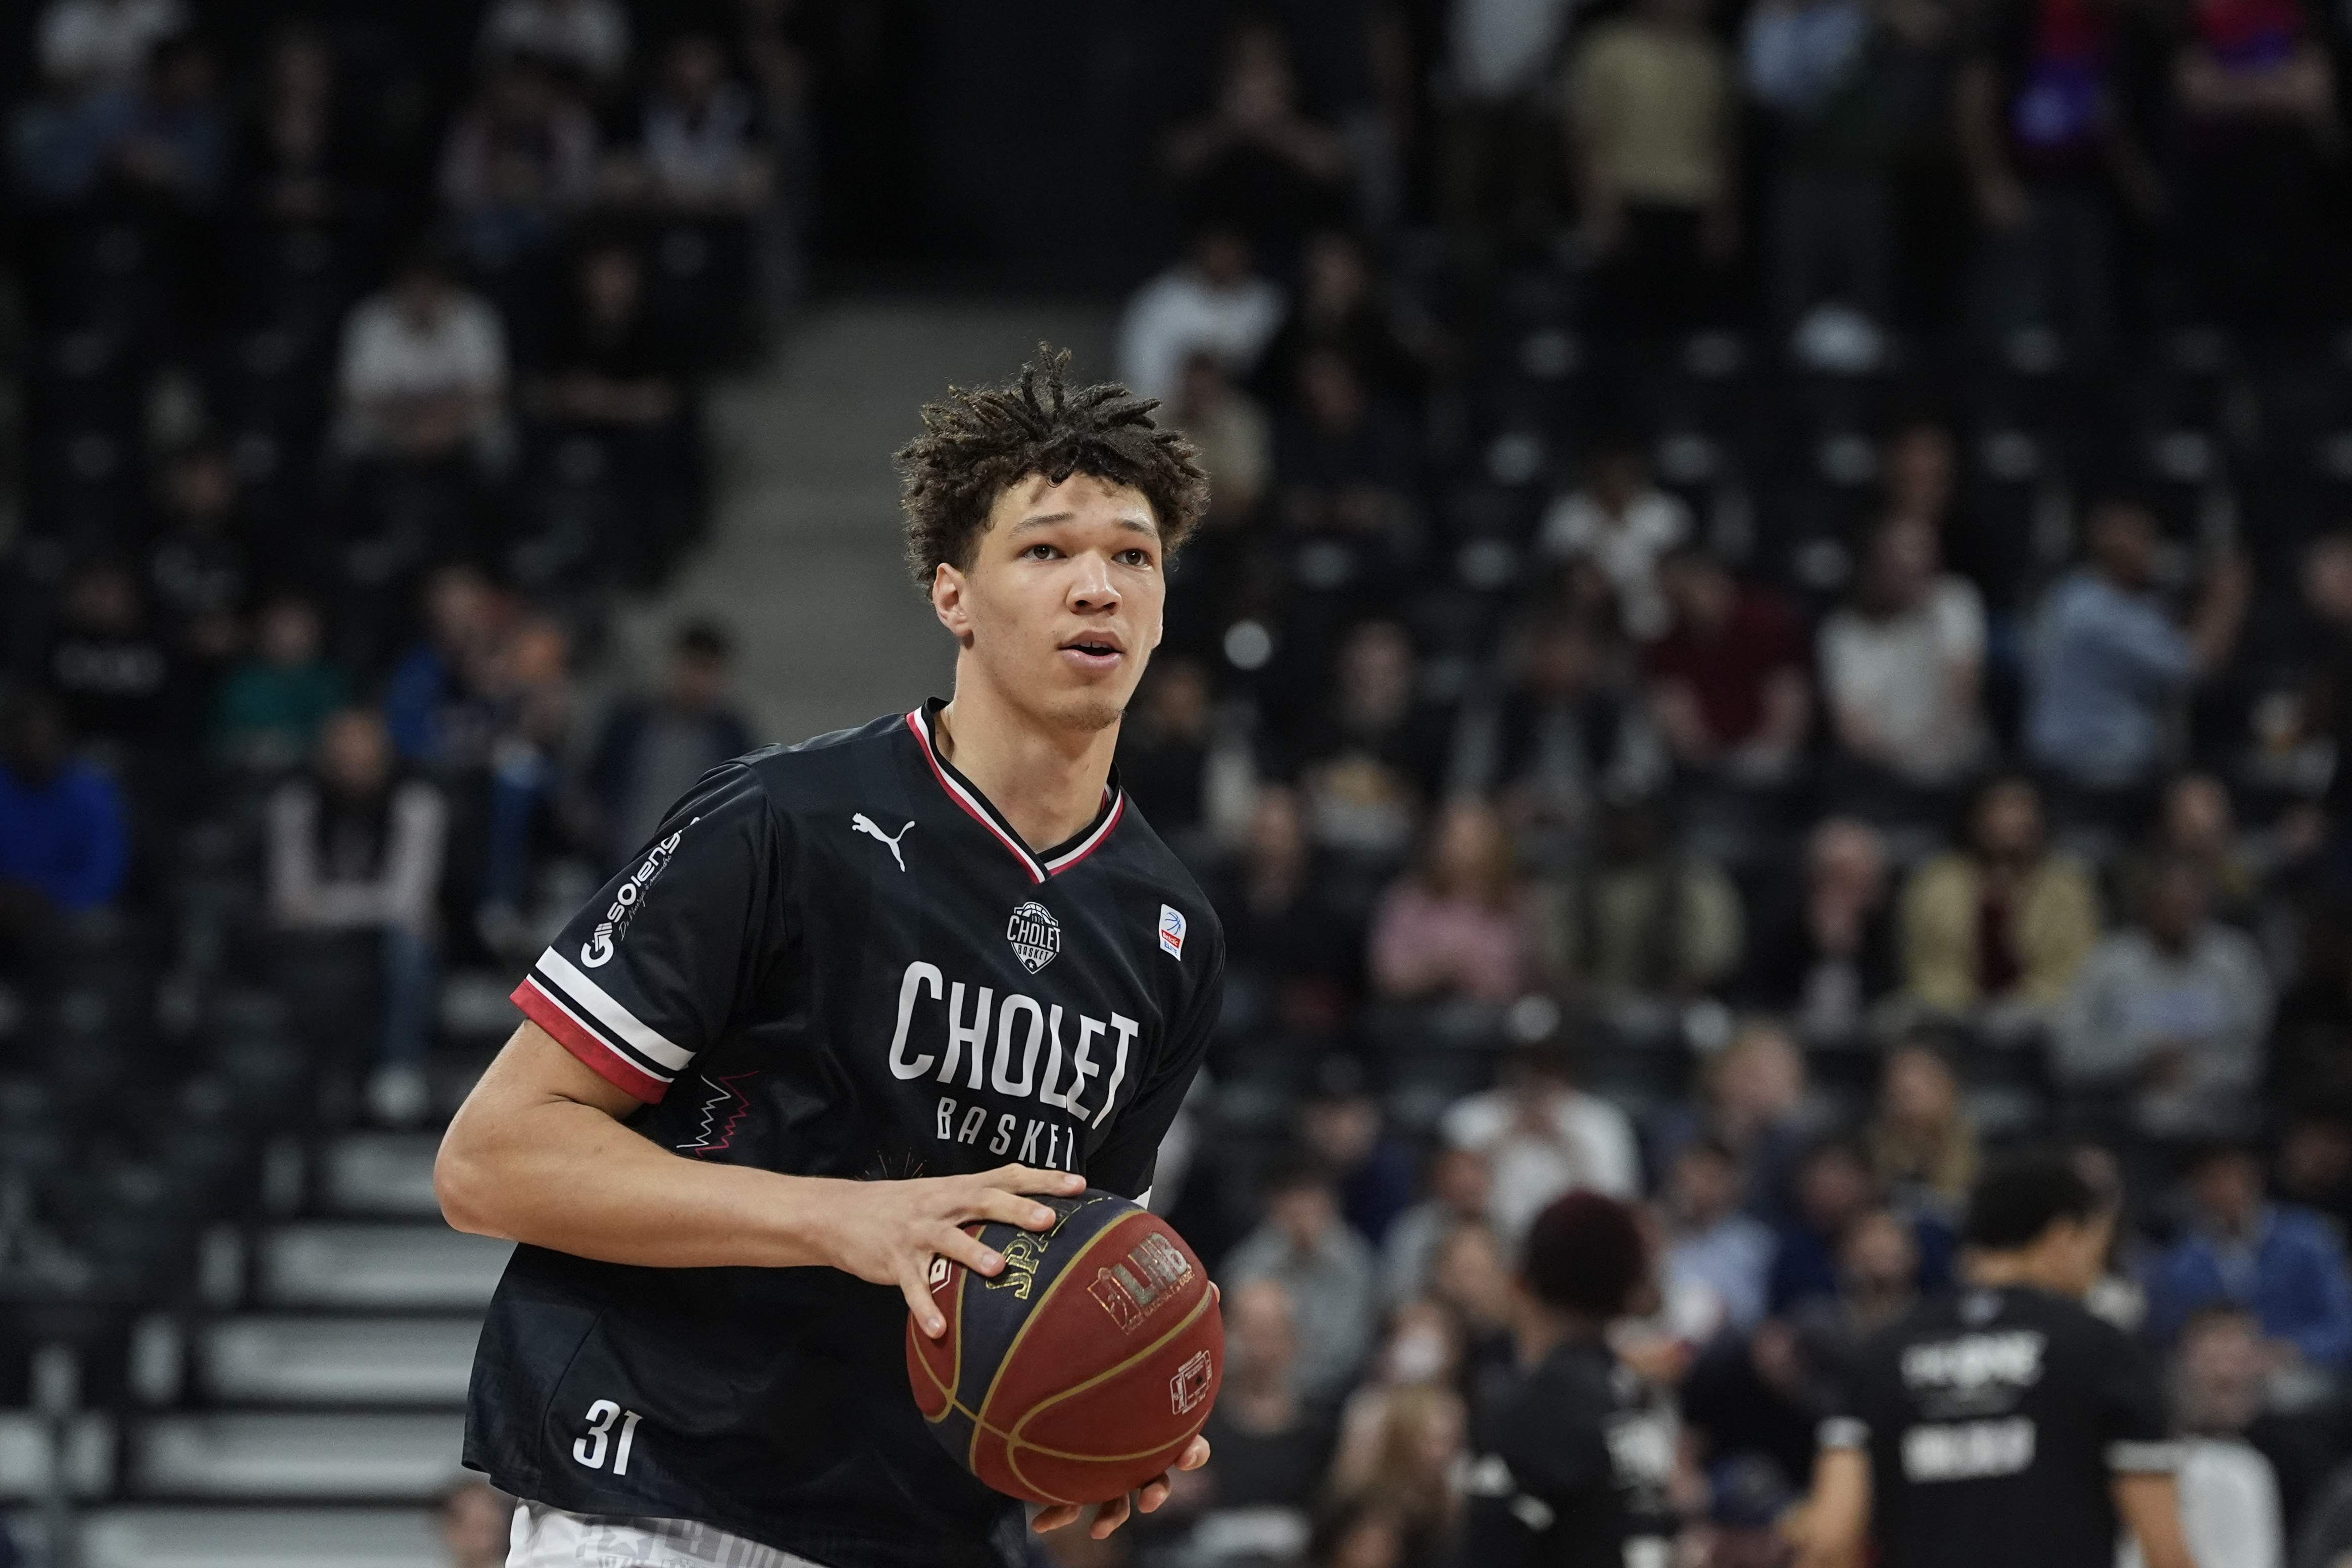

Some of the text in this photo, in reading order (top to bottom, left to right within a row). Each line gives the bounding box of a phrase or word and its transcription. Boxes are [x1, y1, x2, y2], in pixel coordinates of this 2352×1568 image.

[1007, 915, 1061, 953] CHOLET
[1018, 945, 1049, 961] BASKET
[1162, 932, 1179, 946] Betclic
[889, 961, 1139, 1130] CHOLET
[572, 1399, 643, 1476] 31
